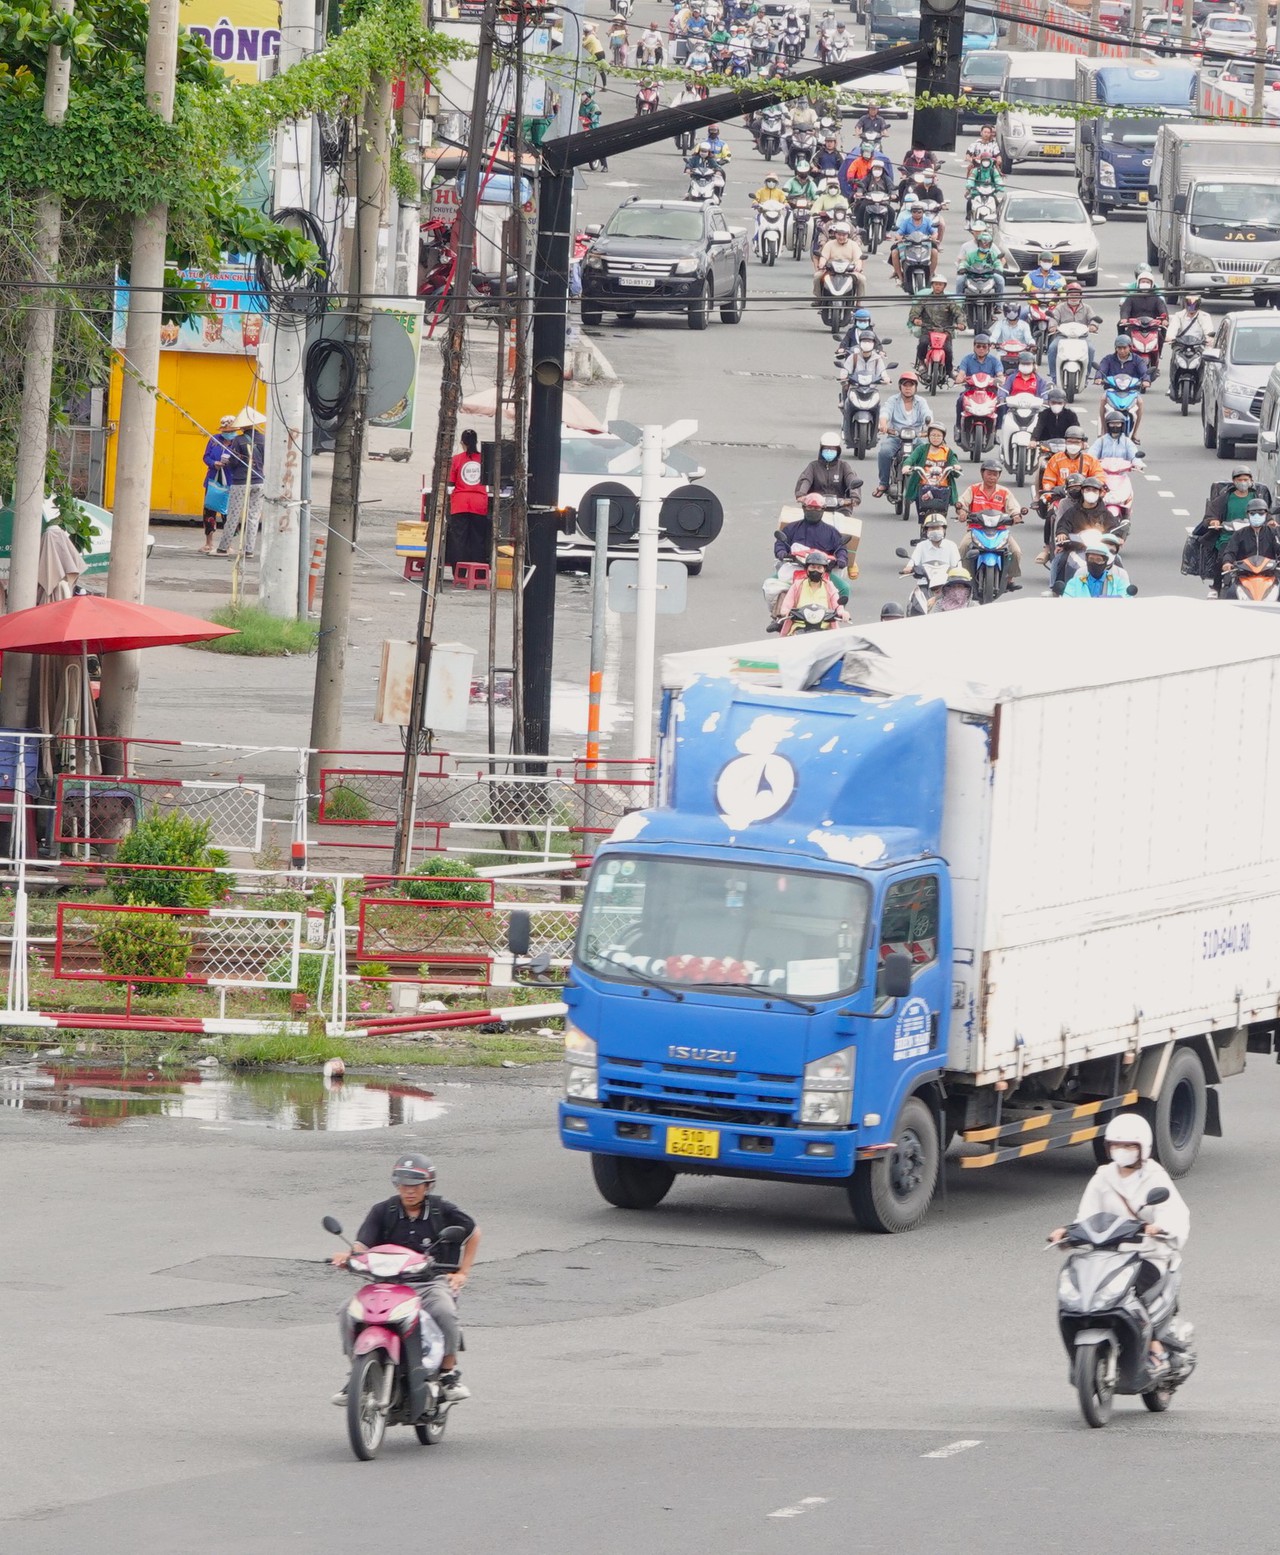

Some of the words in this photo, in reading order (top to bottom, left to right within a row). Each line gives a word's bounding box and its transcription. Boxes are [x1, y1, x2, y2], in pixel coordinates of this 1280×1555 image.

[1224, 232, 1257, 241] JAC
[668, 1045, 737, 1064] ISUZU
[672, 1142, 713, 1156] 640.80
